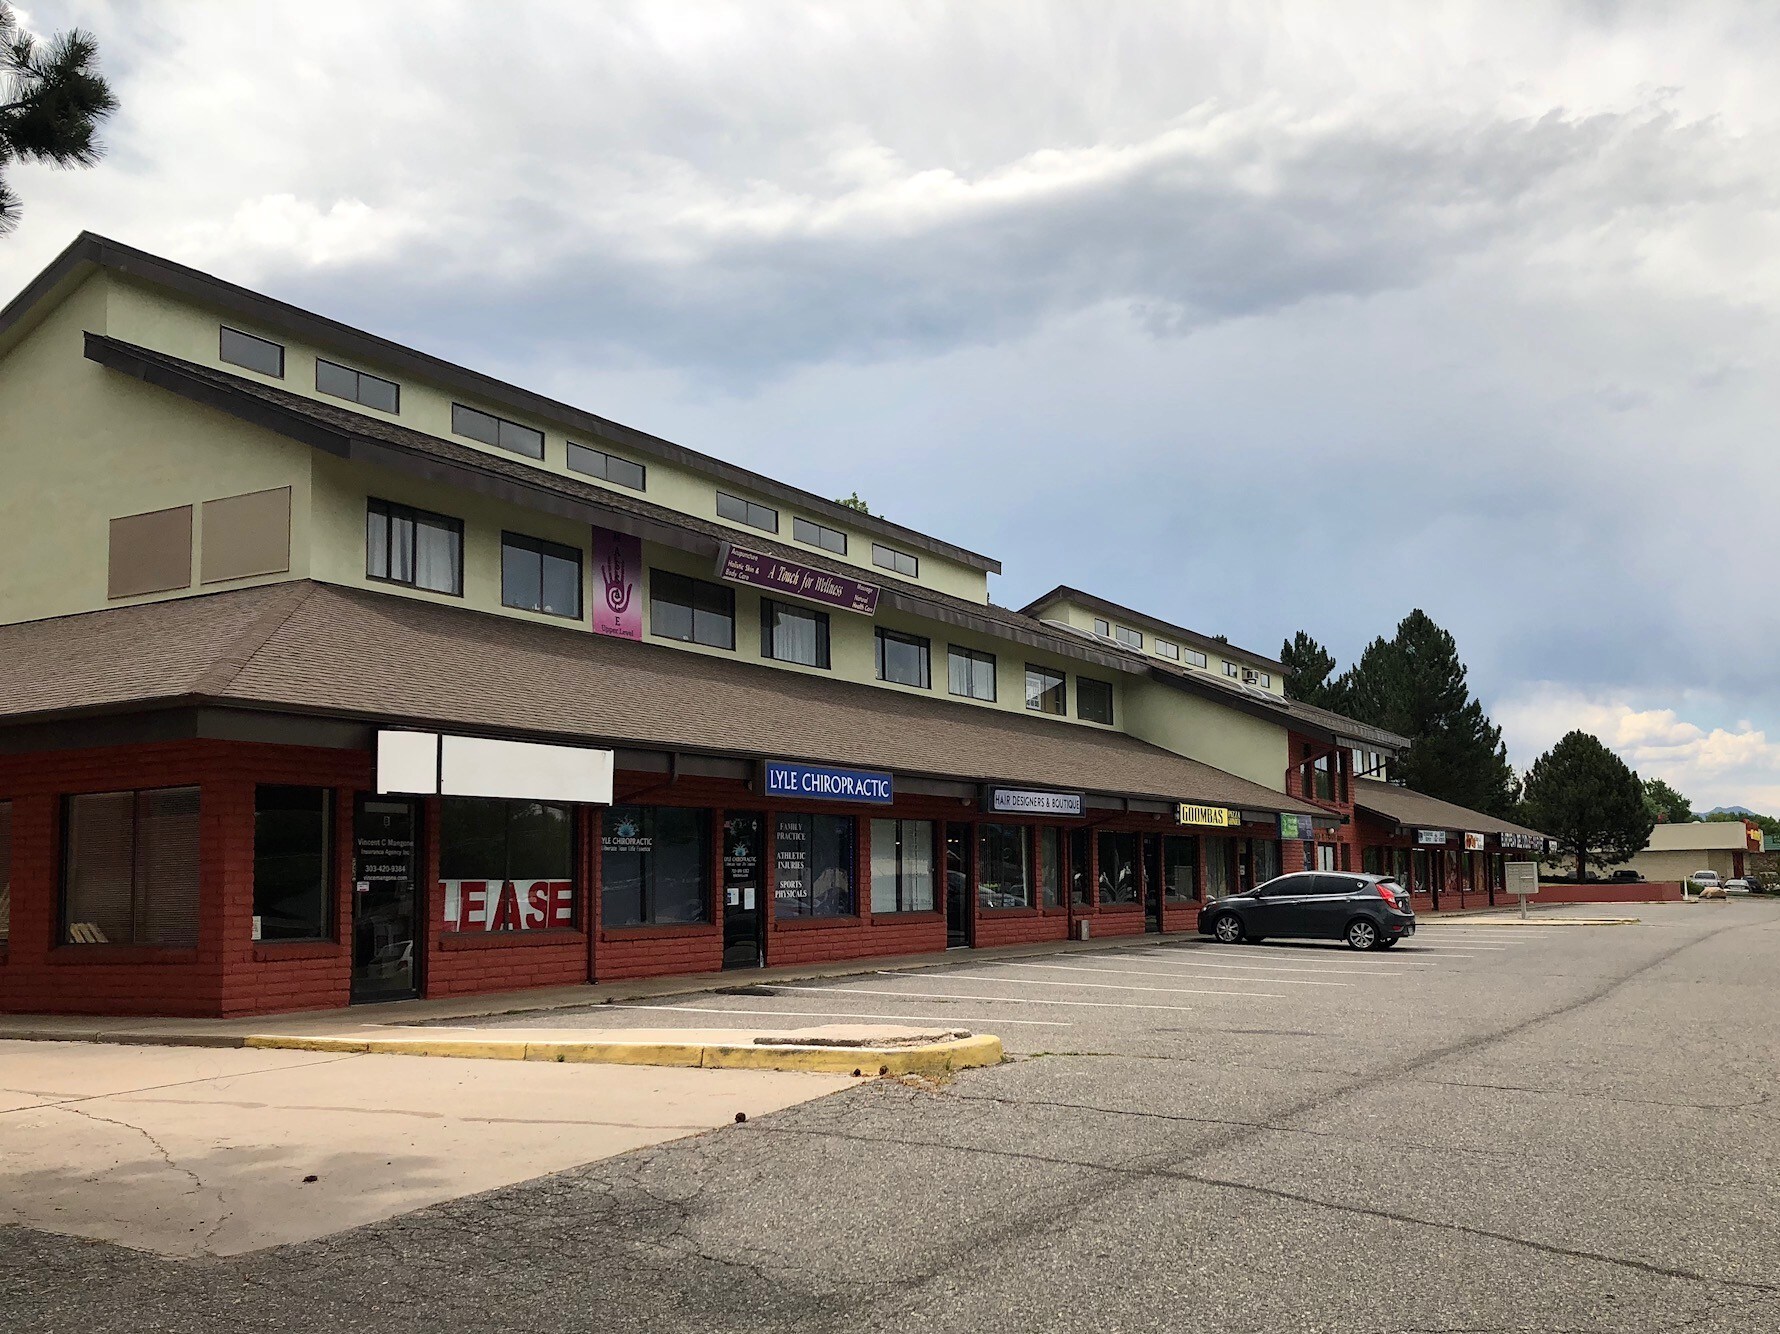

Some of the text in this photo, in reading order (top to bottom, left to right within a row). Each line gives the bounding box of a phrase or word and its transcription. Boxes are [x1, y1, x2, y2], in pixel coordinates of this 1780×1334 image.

[731, 547, 759, 562] Acupuncture
[728, 560, 744, 571] Holistic
[744, 564, 755, 574] Skin
[725, 568, 750, 581] Body Care
[767, 564, 844, 597] A Touch for Wellness
[856, 583, 874, 594] Massage
[854, 594, 869, 603] Natural
[851, 602, 865, 611] Health
[601, 625, 634, 637] Upper Level
[769, 769, 890, 798] LYLE CHIROPRACTIC
[995, 794, 1080, 811] HAIR DESIGNERS & BOUTIQUE
[1182, 806, 1224, 824] GOOMBAS
[780, 822, 803, 831] FAMILY
[776, 832, 806, 841] PRACTICE
[357, 838, 381, 846] Vincent
[612, 837, 653, 846] CHIROPRACTIC
[776, 851, 806, 860] ATHLETIC
[365, 865, 406, 873] 303-420-9384
[778, 861, 805, 869] INJURIES
[780, 880, 803, 889] SPORTS
[775, 889, 808, 898] PHYSICALS
[438, 881, 573, 932] LEASE
